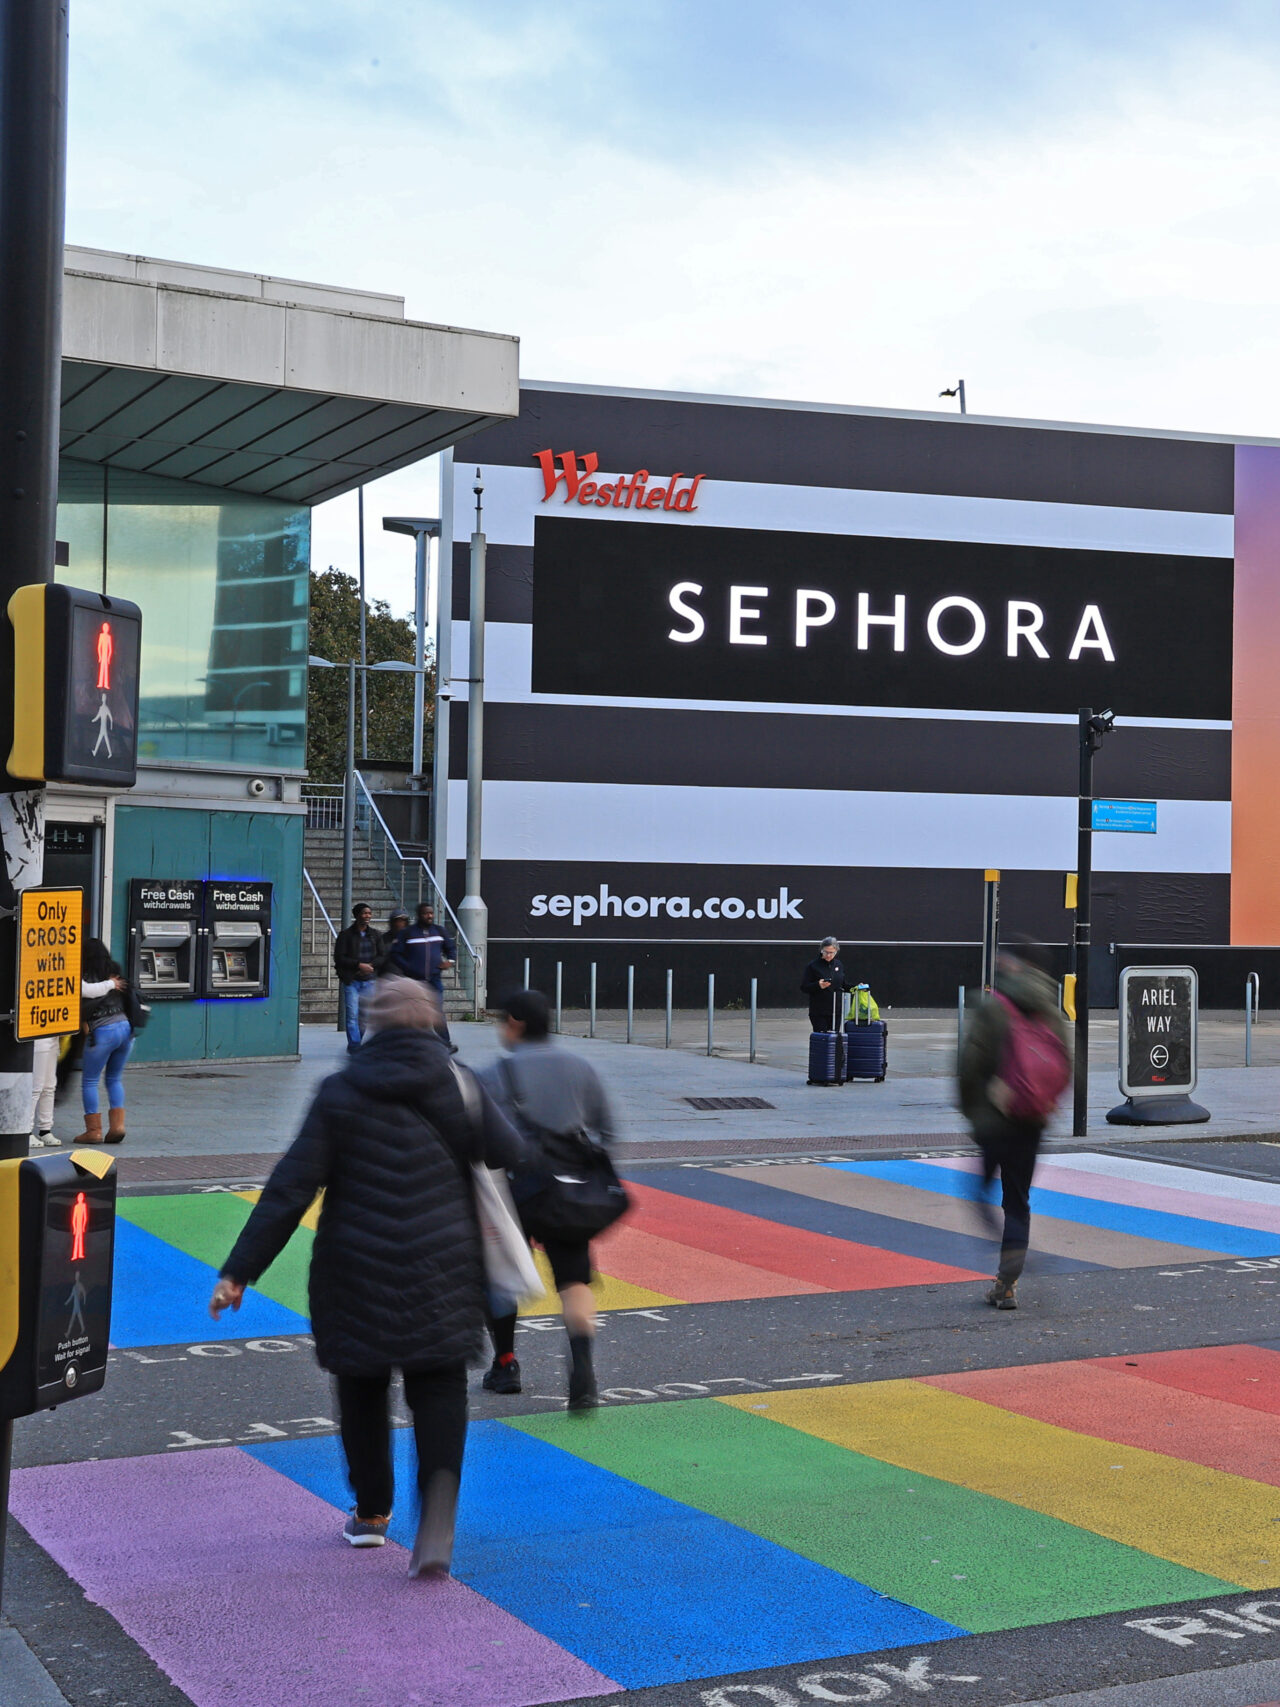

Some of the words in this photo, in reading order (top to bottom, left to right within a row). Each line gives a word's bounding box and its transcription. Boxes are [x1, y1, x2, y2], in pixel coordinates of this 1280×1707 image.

[532, 449, 707, 512] Westfield
[668, 581, 1116, 662] SEPHORA
[141, 889, 166, 900] Free
[168, 889, 195, 900] Cash
[213, 890, 237, 901] Free
[238, 891, 264, 902] Cash
[38, 901, 68, 923] Only
[143, 901, 192, 910] withdrawals
[216, 902, 260, 911] withdrawals
[530, 884, 804, 926] sephora.co.uk
[26, 925, 77, 947] CROSS
[37, 952, 65, 972] with
[25, 976, 75, 999] GREEN
[1141, 988, 1177, 1006] ARIEL
[30, 1006, 69, 1027] figure
[1147, 1015, 1172, 1033] WAY
[54, 1353, 66, 1362] Wait
[66, 1349, 75, 1359] for
[75, 1343, 91, 1356] signal
[57, 1340, 71, 1351] Push
[72, 1336, 89, 1347] button
